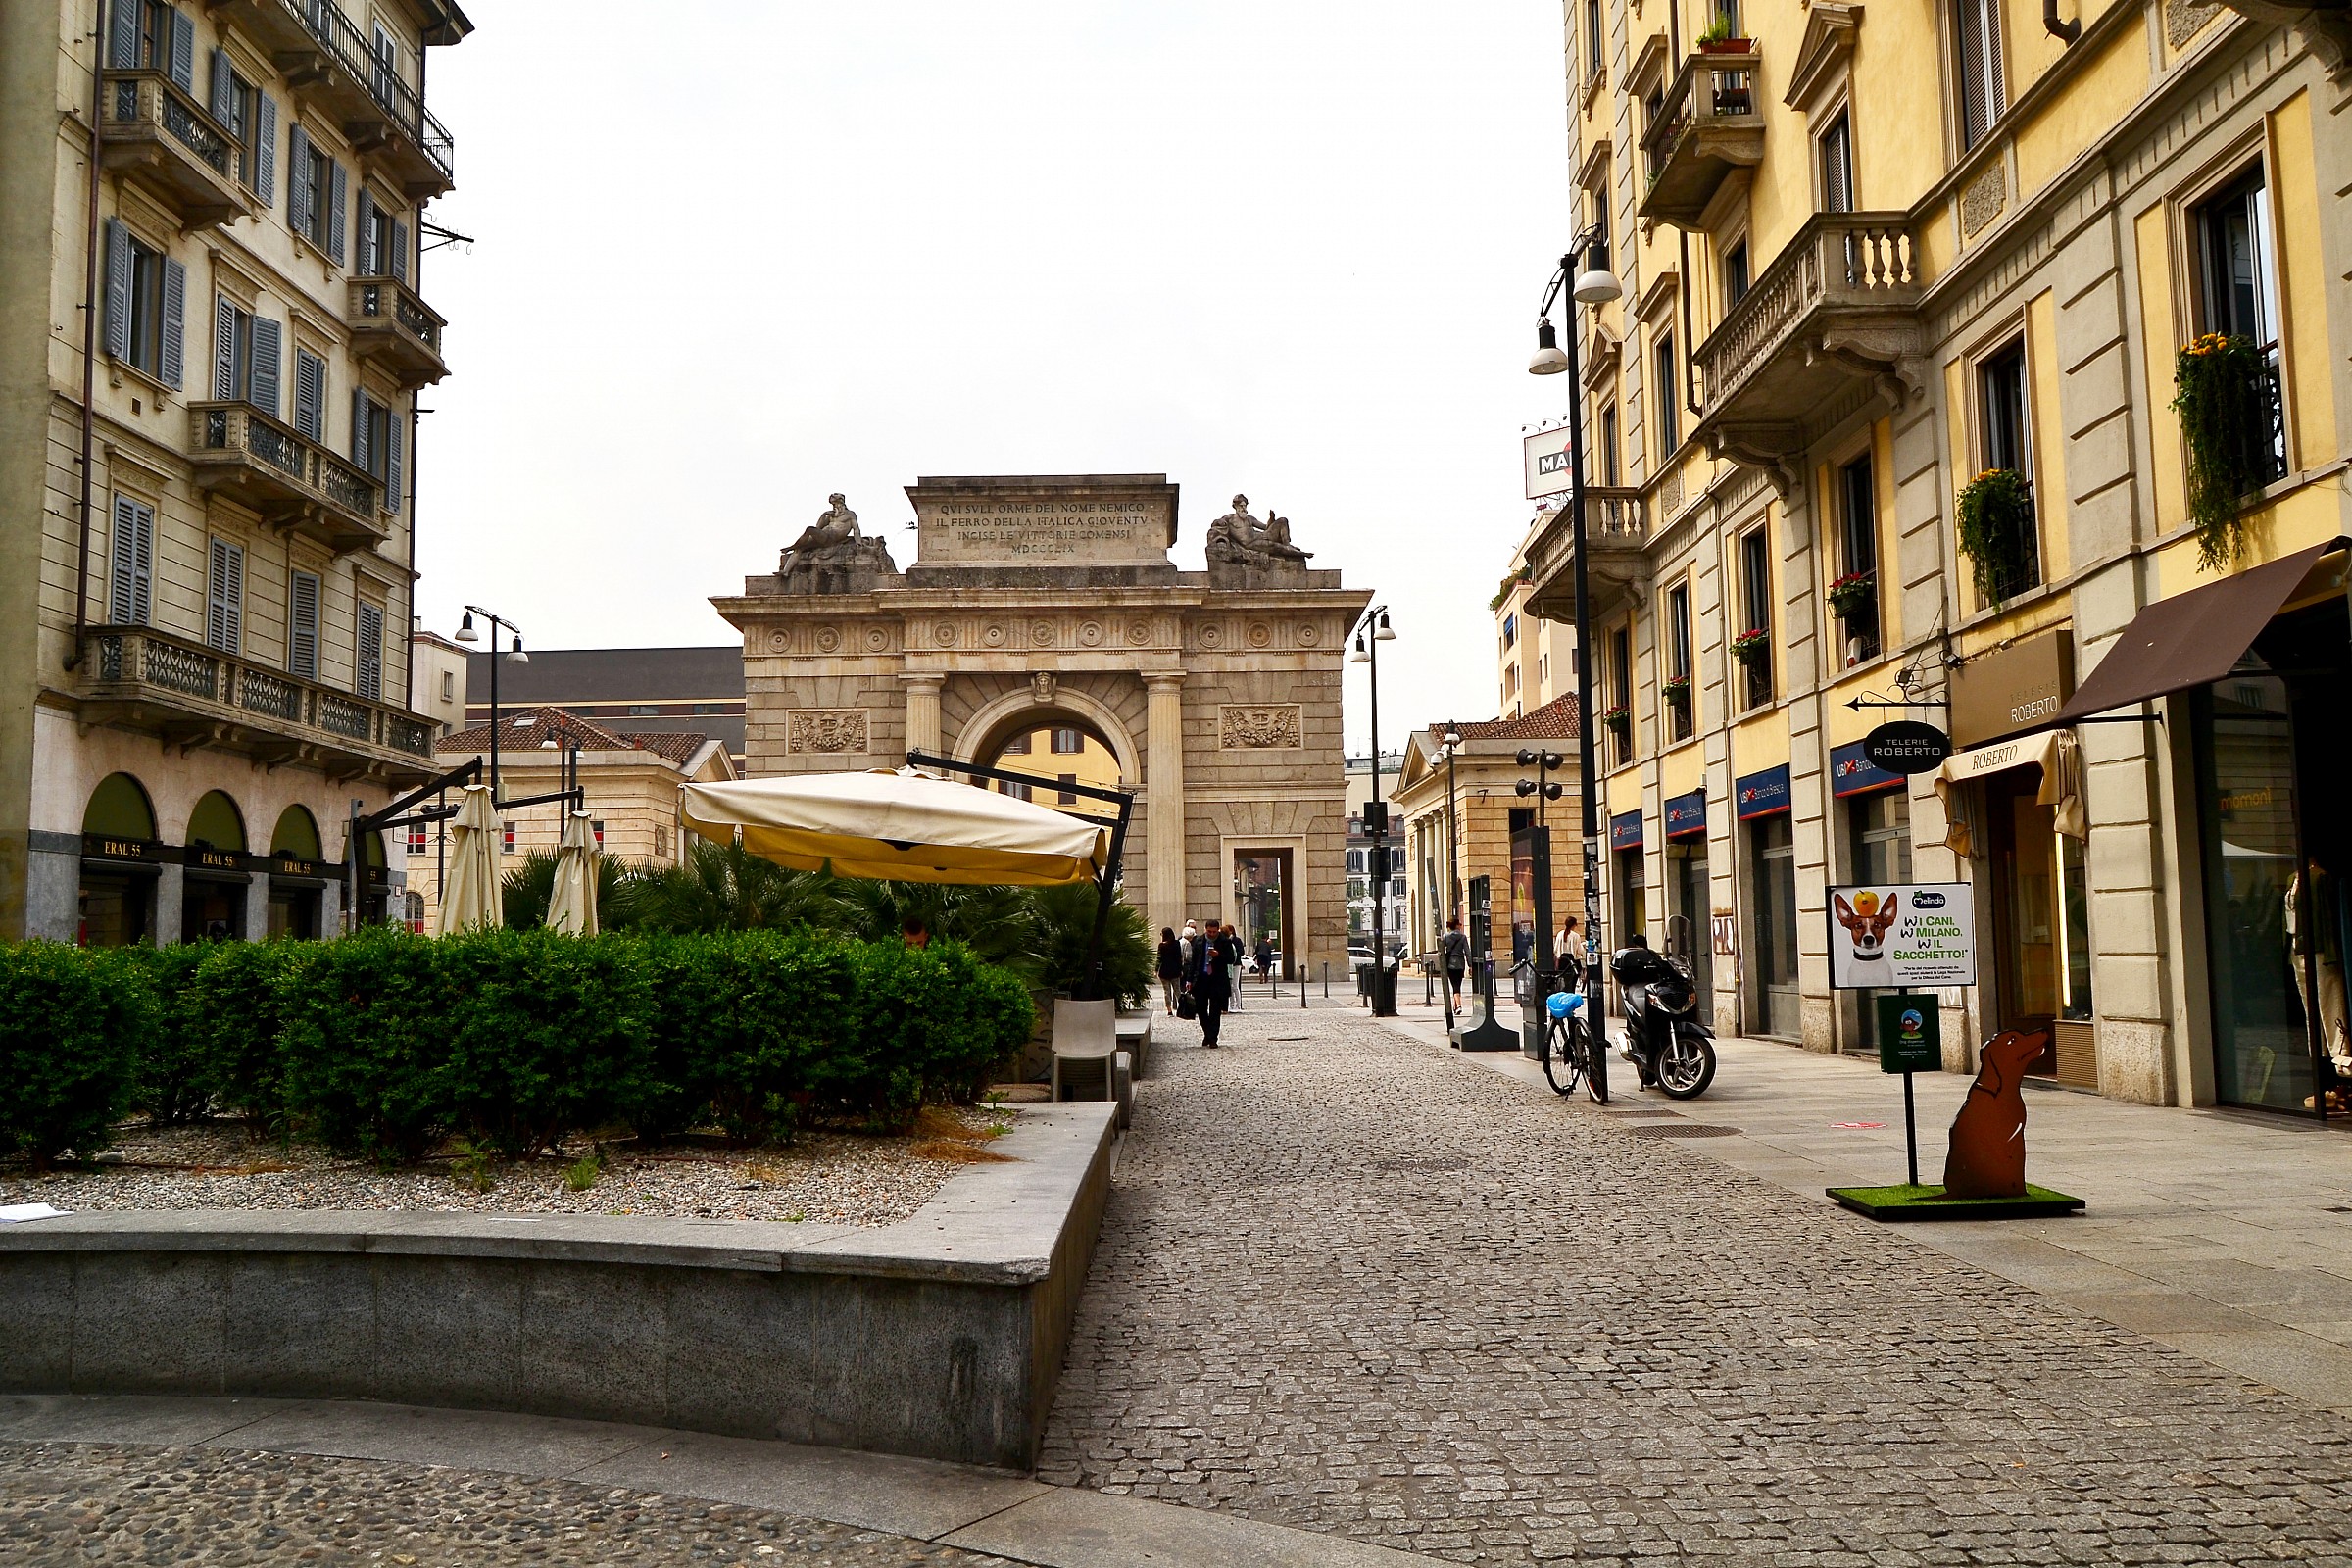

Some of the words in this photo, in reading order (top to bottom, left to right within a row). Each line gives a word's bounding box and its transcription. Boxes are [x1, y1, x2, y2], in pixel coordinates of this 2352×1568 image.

[1541, 451, 1572, 473] MA
[941, 505, 961, 515] QVI
[998, 504, 1032, 514] ORME
[1035, 504, 1056, 513] DEL
[1061, 503, 1096, 513] NOME
[1099, 503, 1145, 513] NEMICO
[936, 517, 948, 527] IL
[951, 517, 990, 527] FERRO
[994, 517, 1032, 527] DELLA
[1037, 516, 1084, 526] ITALICA
[1087, 515, 1149, 526] GIOVENTV
[957, 531, 996, 541] INCISE
[1000, 531, 1013, 540] LE
[1018, 530, 1076, 540] VITTORIE
[1079, 529, 1130, 540] COMENSI
[2011, 695, 2058, 723] ROBERTO
[1874, 747, 1941, 756] ROBERTO
[1972, 744, 2018, 770] ROBERTO
[104, 841, 128, 856] ERAL
[131, 844, 141, 857] 55
[202, 853, 222, 865] ERAL
[224, 855, 233, 867] 55
[284, 861, 302, 873] ERAL
[303, 863, 311, 874] 55
[1913, 895, 1944, 905] Melinda
[1933, 939, 1943, 949] IL
